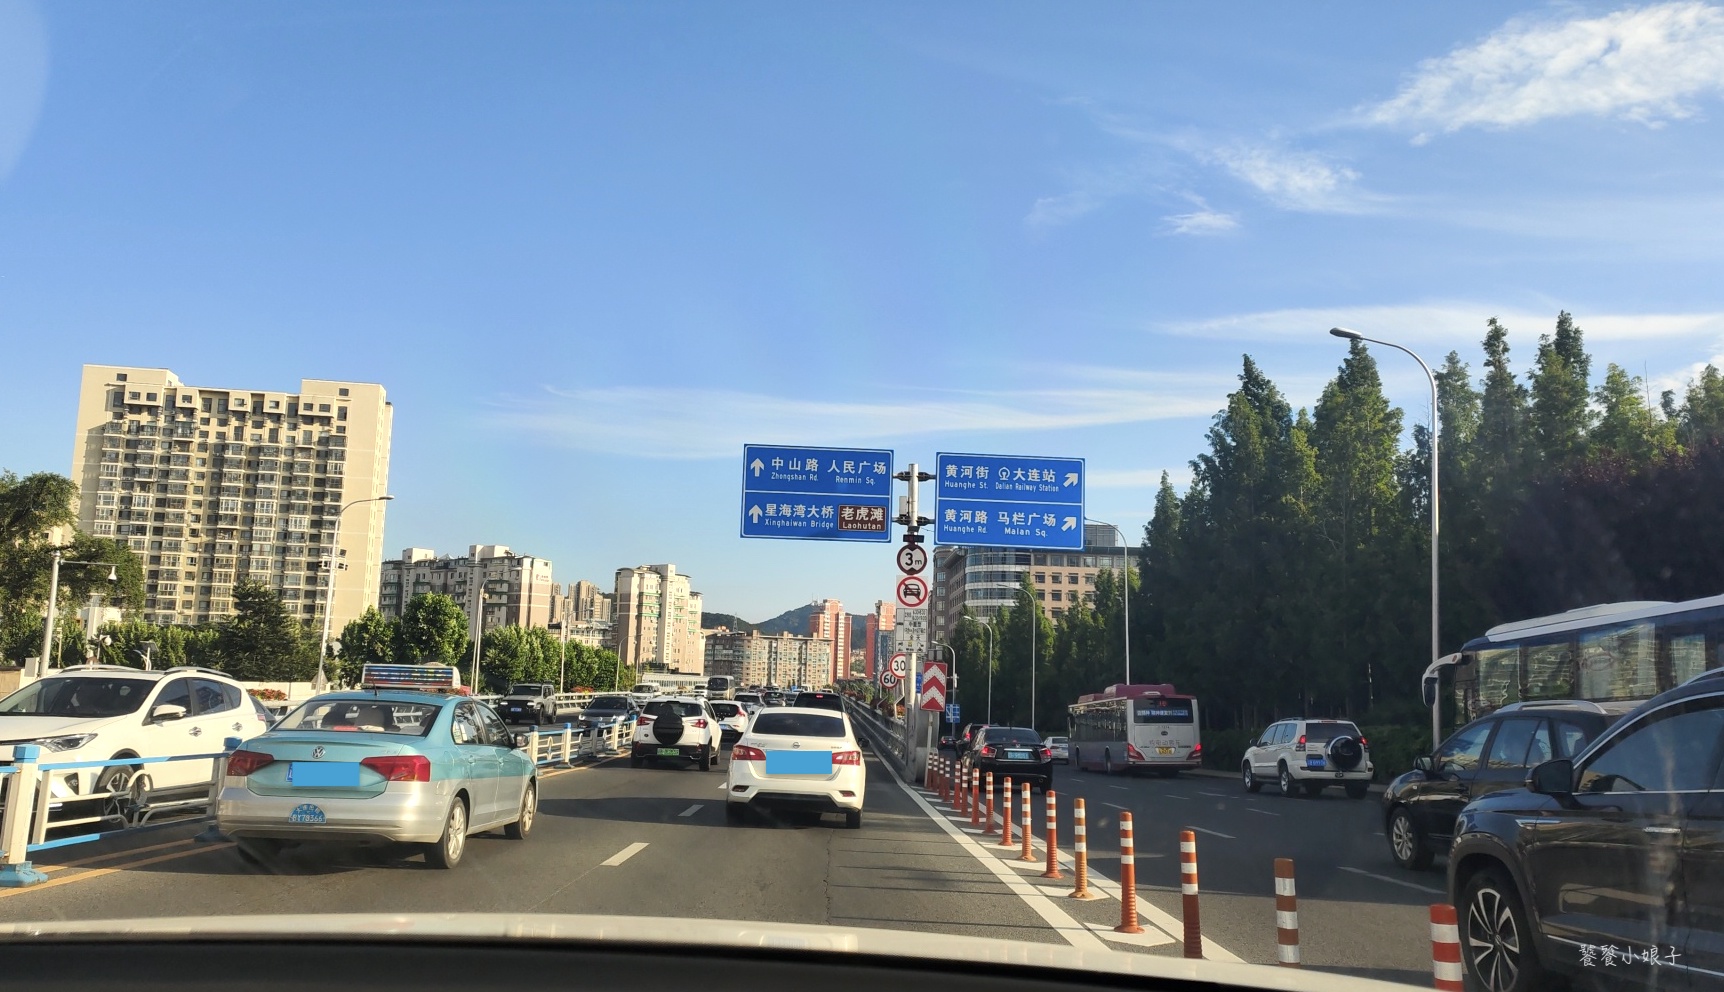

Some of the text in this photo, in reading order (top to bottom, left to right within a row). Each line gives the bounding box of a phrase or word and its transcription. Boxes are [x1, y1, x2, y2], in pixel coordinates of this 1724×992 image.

[771, 457, 886, 475] 中山路 人民广场
[771, 472, 806, 482] Zhongshan
[836, 475, 862, 484] Renmin
[865, 476, 876, 486] Sq.
[945, 464, 1056, 483] 黄河街 大连站
[944, 480, 1059, 493] Huanghe St. Dalian Railway Station
[765, 503, 884, 522] 星海湾大桥 老虎滩
[944, 508, 1056, 527] 黄河路 马栏广场
[764, 518, 882, 530] Xinghaiwan Bridge Laohutan
[943, 524, 975, 534] Huanghe
[1004, 527, 1031, 536] Malan
[1035, 528, 1048, 538] Sq.
[893, 660, 906, 672] 30
[883, 674, 896, 684] 60
